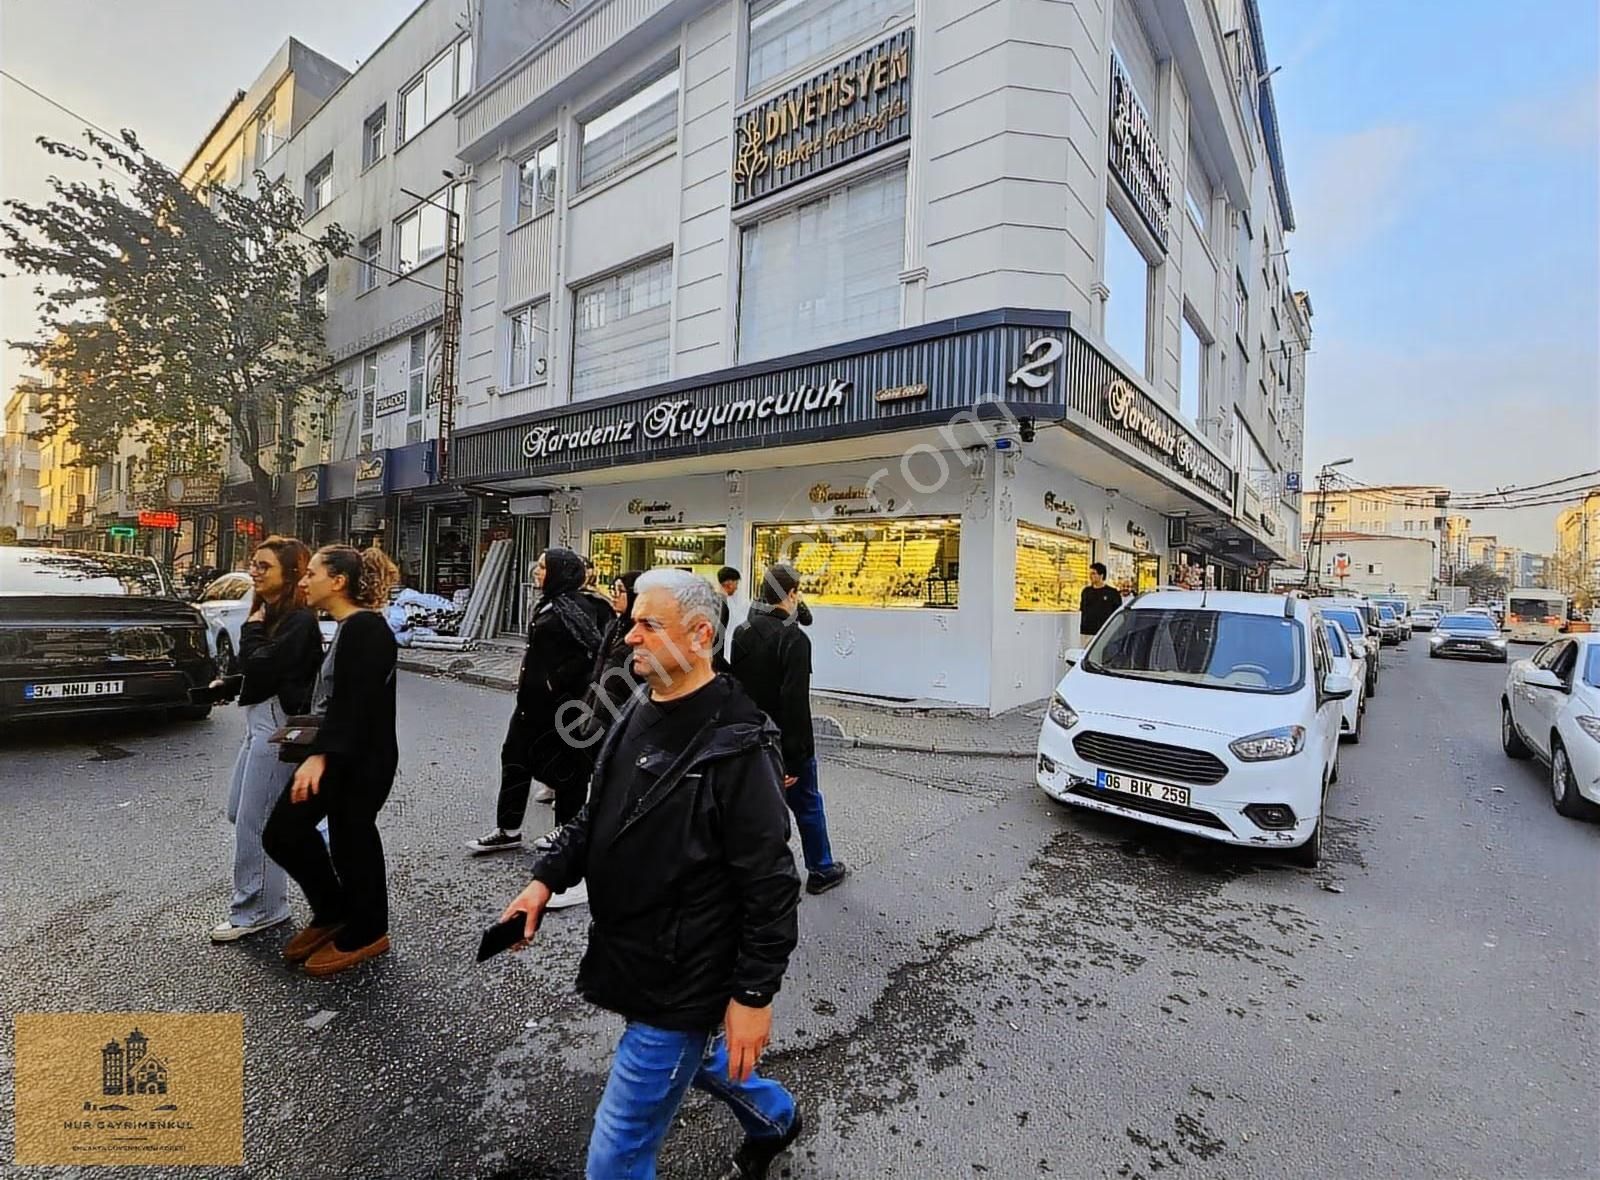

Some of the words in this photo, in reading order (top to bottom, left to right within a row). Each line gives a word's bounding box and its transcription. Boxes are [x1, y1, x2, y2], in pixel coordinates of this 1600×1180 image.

[765, 46, 909, 144] DİYETİSYEN
[1008, 337, 1064, 388] 2
[522, 420, 633, 458] Karadeniz
[643, 378, 849, 439] Kuyumculuk
[1109, 379, 1176, 455] Karadeniz
[34, 686, 52, 697] 34
[62, 683, 89, 696] NNU
[94, 681, 120, 693] 811
[1105, 774, 1121, 790] 06
[1130, 779, 1153, 797] BIK
[1161, 786, 1187, 805] 259
